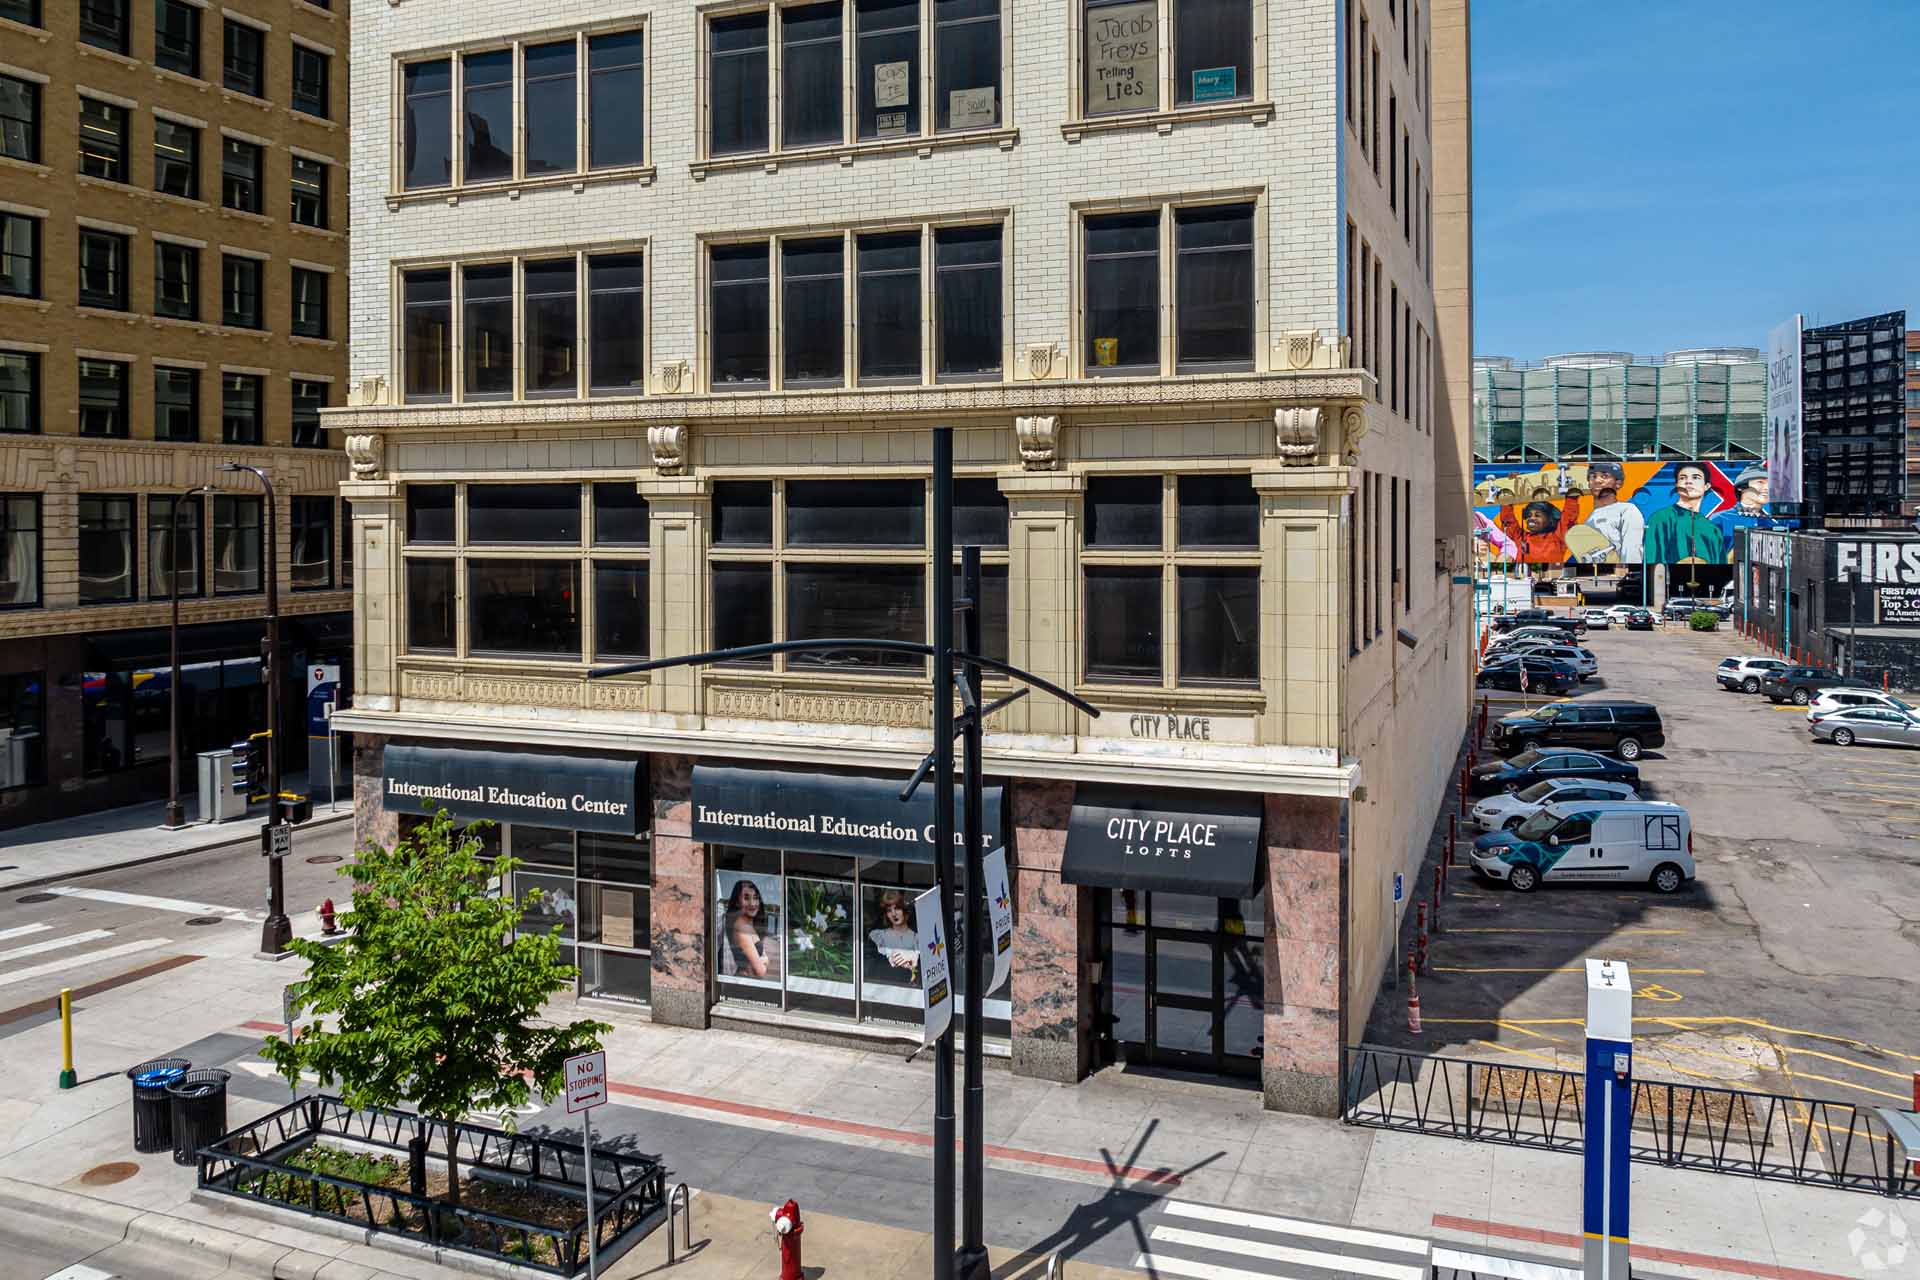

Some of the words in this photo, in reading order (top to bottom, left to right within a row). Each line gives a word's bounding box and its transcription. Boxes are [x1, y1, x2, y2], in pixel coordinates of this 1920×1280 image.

[1096, 14, 1153, 42] Jacob
[1096, 66, 1135, 81] Telling
[1881, 599, 1902, 611] Top
[1903, 599, 1910, 609] 3
[1130, 714, 1161, 738] CITY
[1168, 715, 1210, 741] PLACE
[387, 778, 485, 804] International
[488, 786, 568, 811] Education
[571, 794, 628, 816] Center
[274, 827, 289, 837] ONE
[698, 805, 816, 833] International
[820, 816, 918, 842] Education
[1107, 817, 1151, 841] CITY
[1154, 821, 1218, 847] PLACE
[274, 836, 289, 846] WAY
[1125, 845, 1192, 859] LOFTS
[995, 912, 1010, 930] PRIDE
[926, 959, 945, 980] PRIDE
[577, 1062, 594, 1076] NO
[569, 1073, 604, 1092] STOPPING
